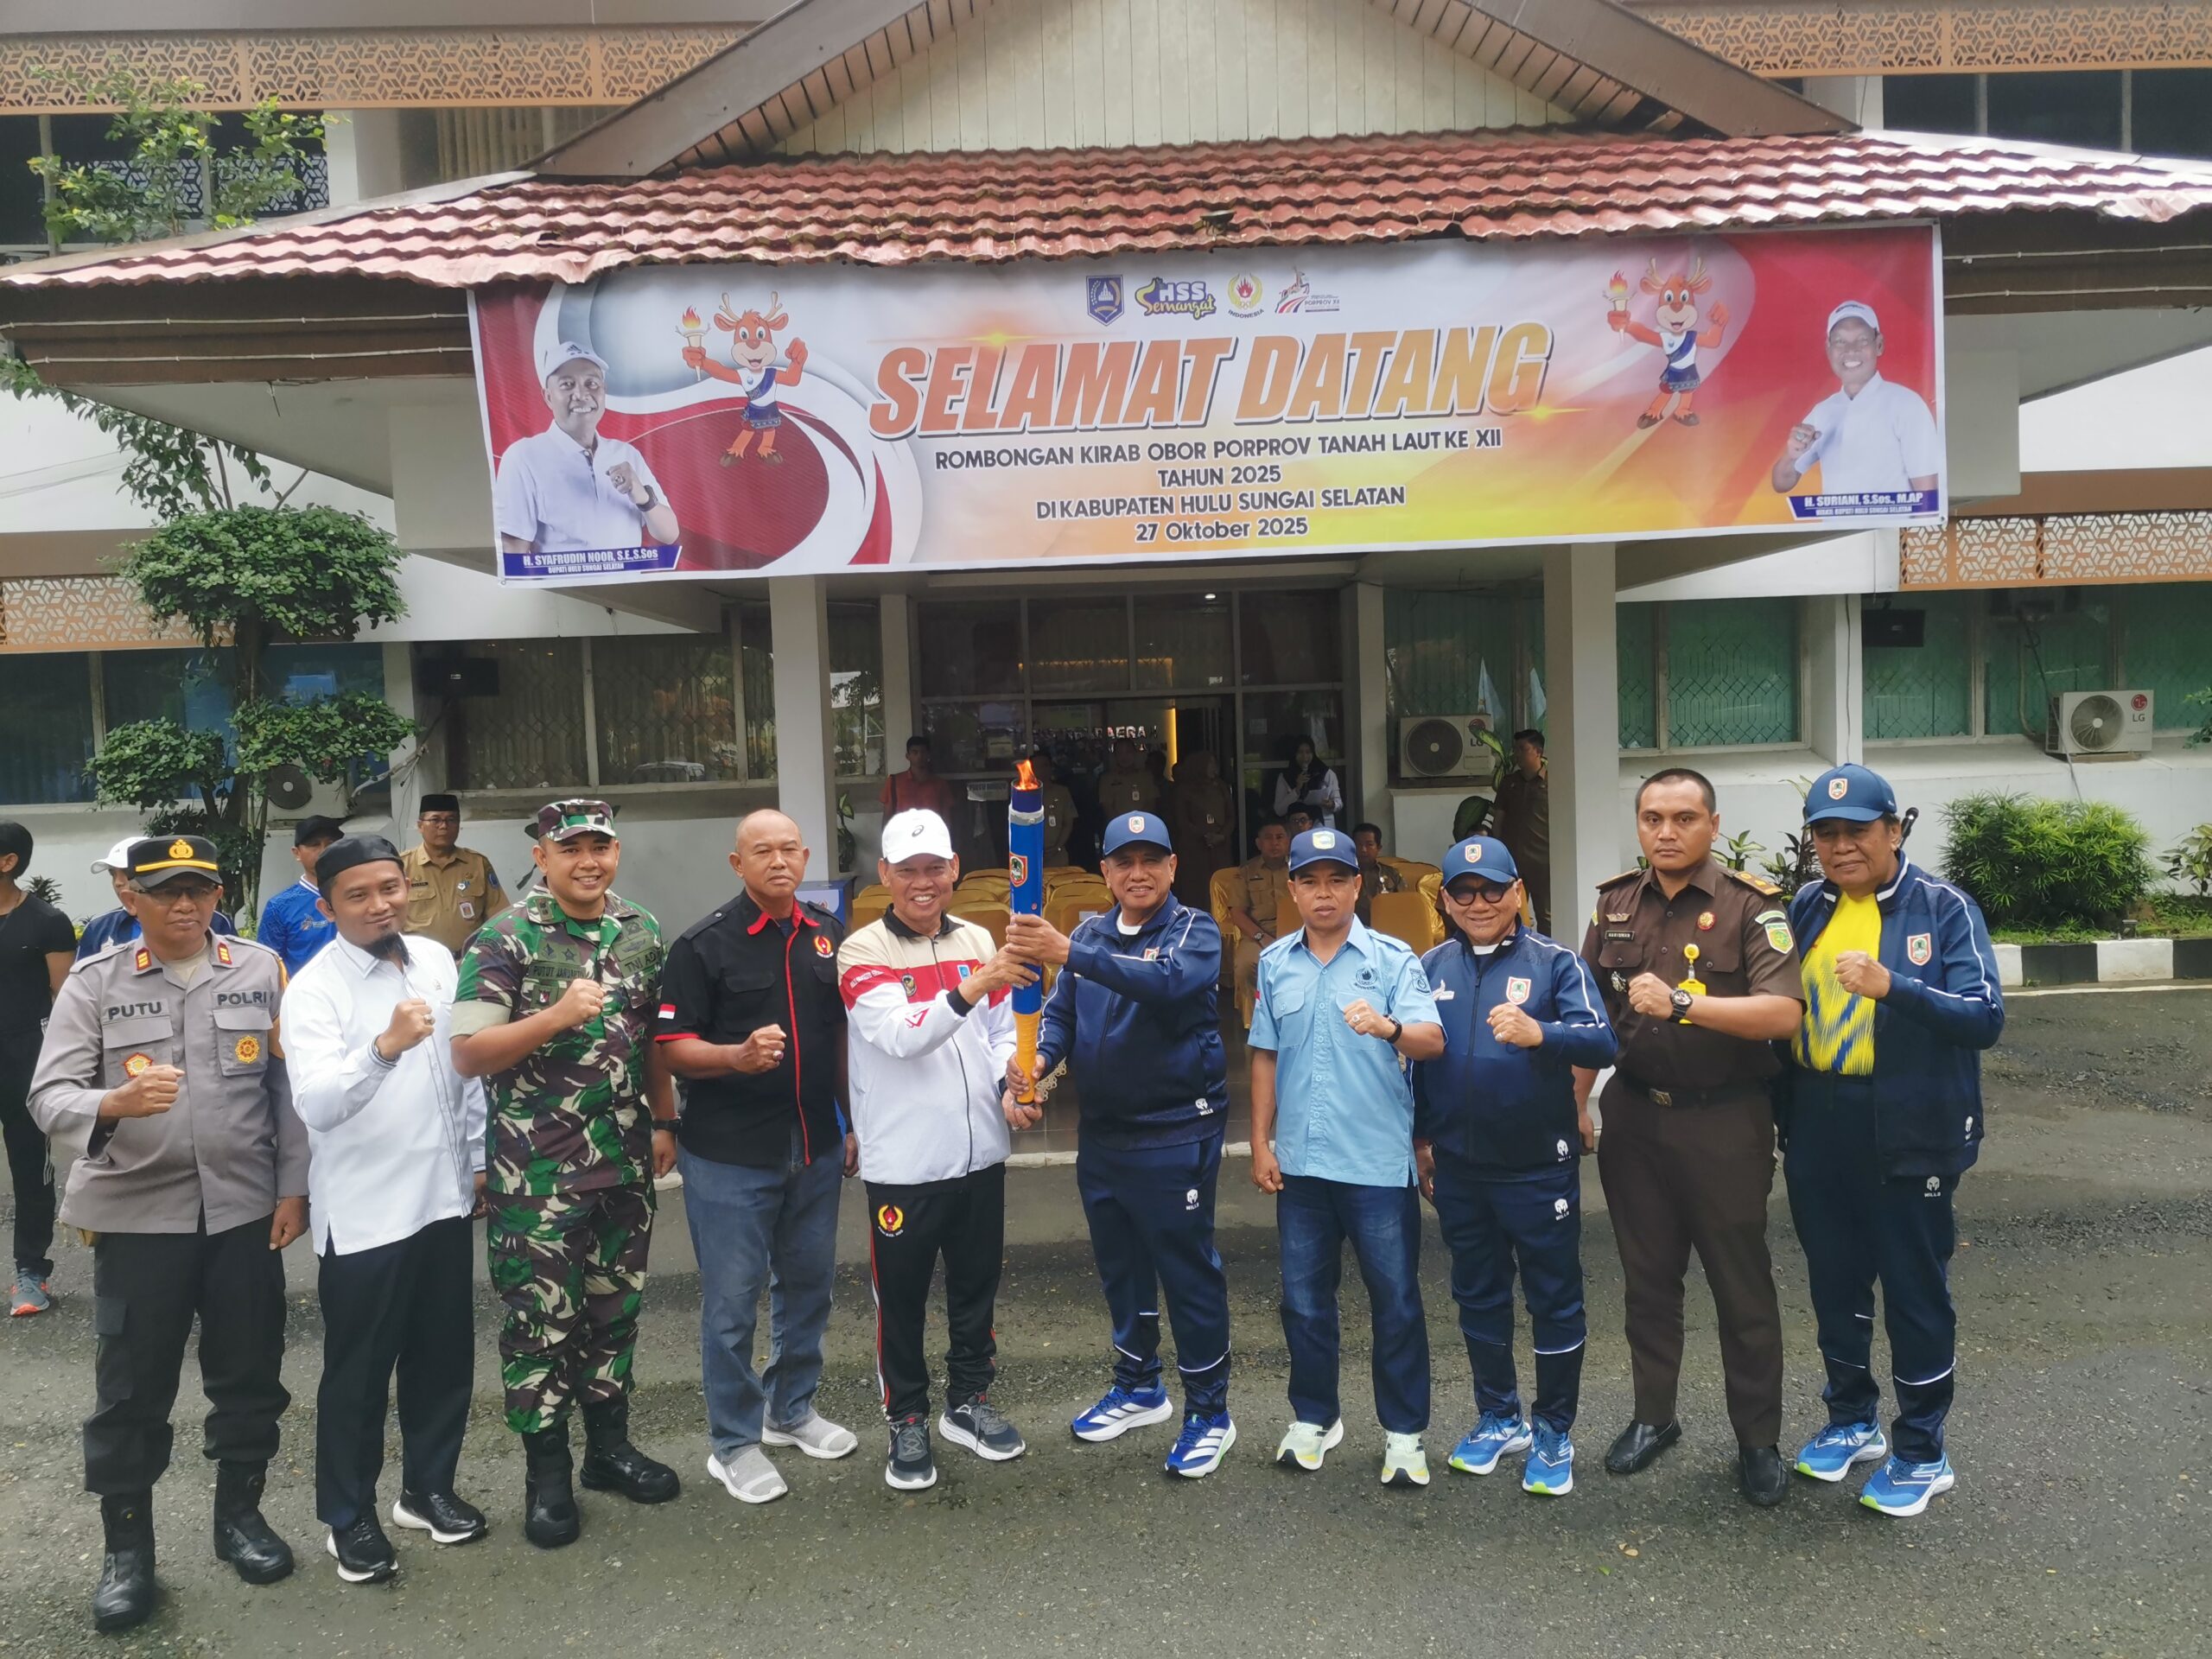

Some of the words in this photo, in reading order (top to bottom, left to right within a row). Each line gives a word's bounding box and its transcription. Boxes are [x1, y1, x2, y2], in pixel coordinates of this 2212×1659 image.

[1135, 277, 1216, 320] Semangat
[1159, 282, 1205, 302] HSS
[1228, 308, 1264, 319] INDONESIA
[868, 336, 1237, 442] SELAMAT
[1233, 321, 1554, 426] DATANG
[935, 446, 1074, 469] ROMBONGAN
[1080, 443, 1141, 464] KIRAB
[1147, 441, 1206, 461] OBOR
[1213, 435, 1312, 459] PORPROV
[1319, 433, 1386, 454] TANAH
[1392, 430, 1441, 451] LAUT
[1444, 429, 1469, 449] KE
[1476, 429, 1503, 448] XII
[1158, 467, 1224, 487] TAHUN
[1230, 464, 1281, 486] 2025
[1036, 500, 1057, 519] DI
[1059, 496, 1174, 518] KABUPATEN
[1180, 493, 1232, 514] HULU
[1237, 490, 1315, 512] SUNGAI
[1321, 486, 1406, 508] SELATAN
[1804, 497, 1815, 507] H.
[1897, 493, 1923, 503] M.AP
[1135, 523, 1158, 543] 27
[1165, 520, 1250, 541] Oktober
[1257, 518, 1308, 537] 2025
[523, 556, 533, 566] H.
[534, 553, 587, 566] SYAFRUDIN
[2132, 713, 2145, 722] LG
[625, 958, 644, 972] TNI
[645, 952, 657, 966] AD
[217, 991, 267, 1006] POLRI
[108, 1001, 162, 1020] PUTU
